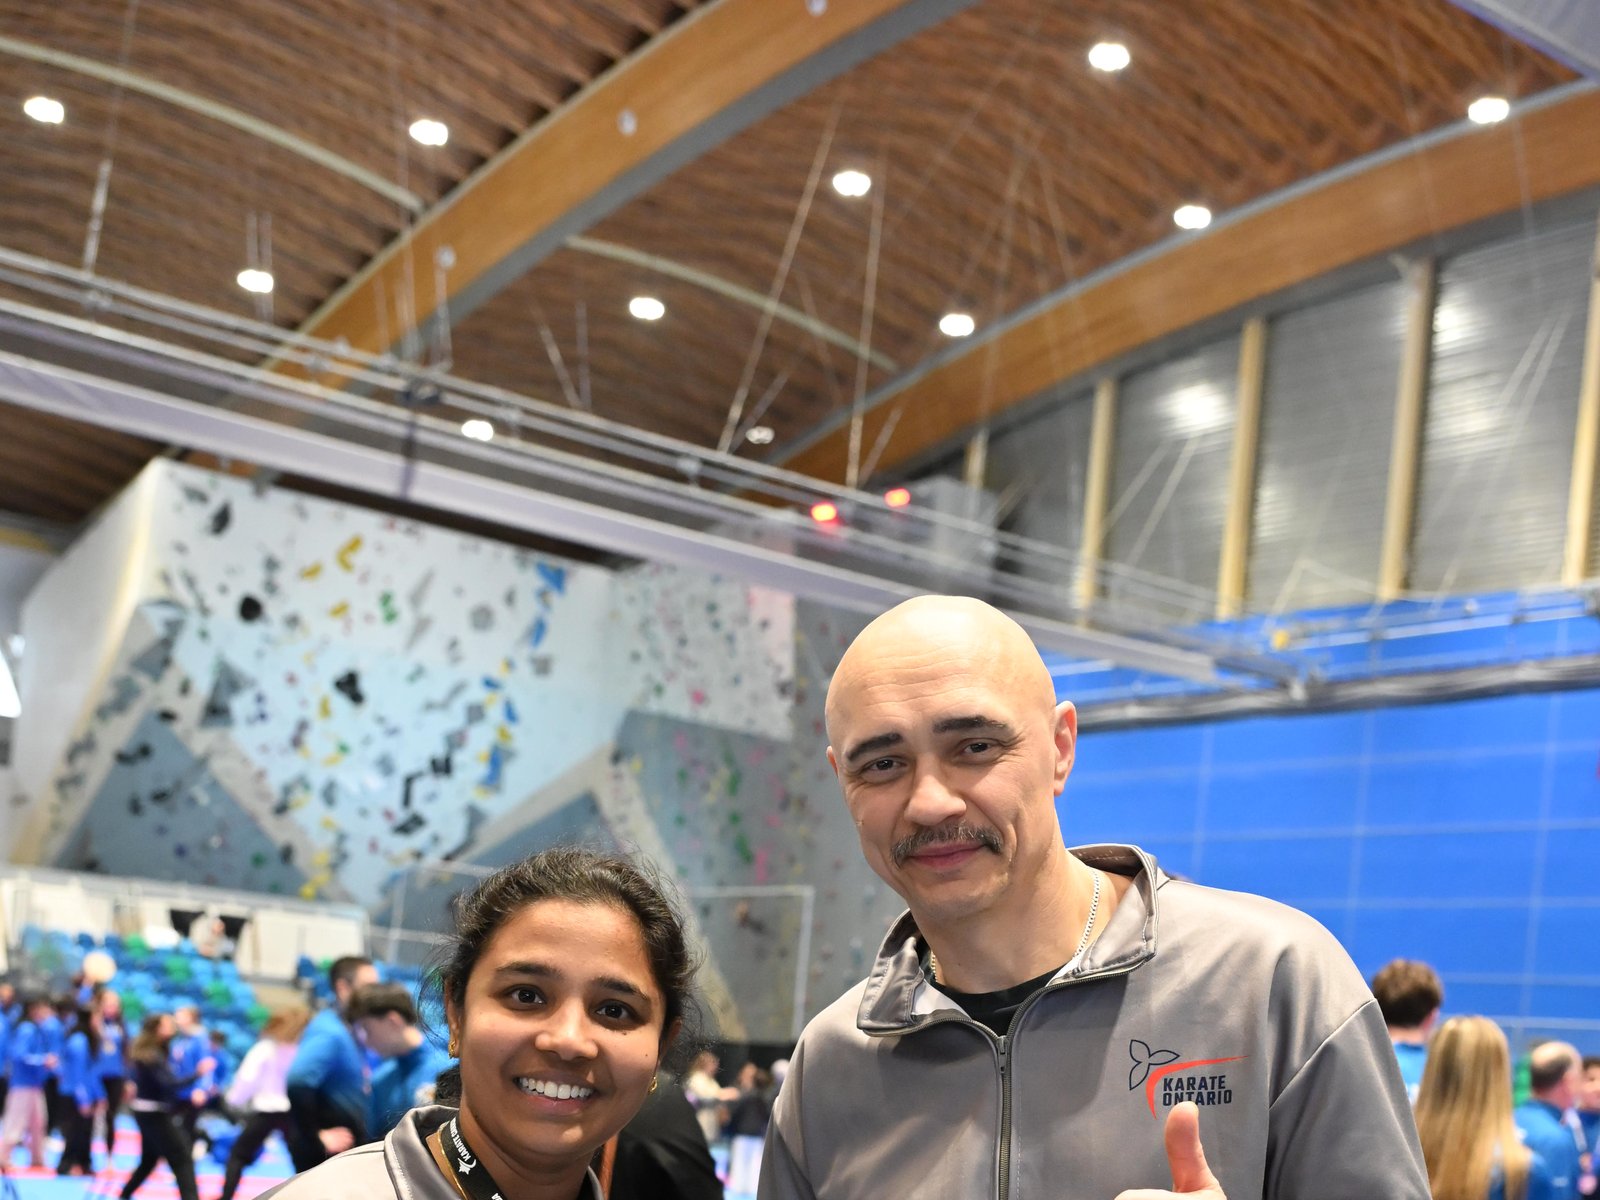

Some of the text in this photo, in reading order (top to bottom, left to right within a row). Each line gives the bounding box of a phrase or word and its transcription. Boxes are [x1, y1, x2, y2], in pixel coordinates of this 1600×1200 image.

[1163, 1075, 1226, 1091] KARATE
[1162, 1089, 1232, 1106] ONTARIO
[453, 1134, 472, 1162] KARATE
